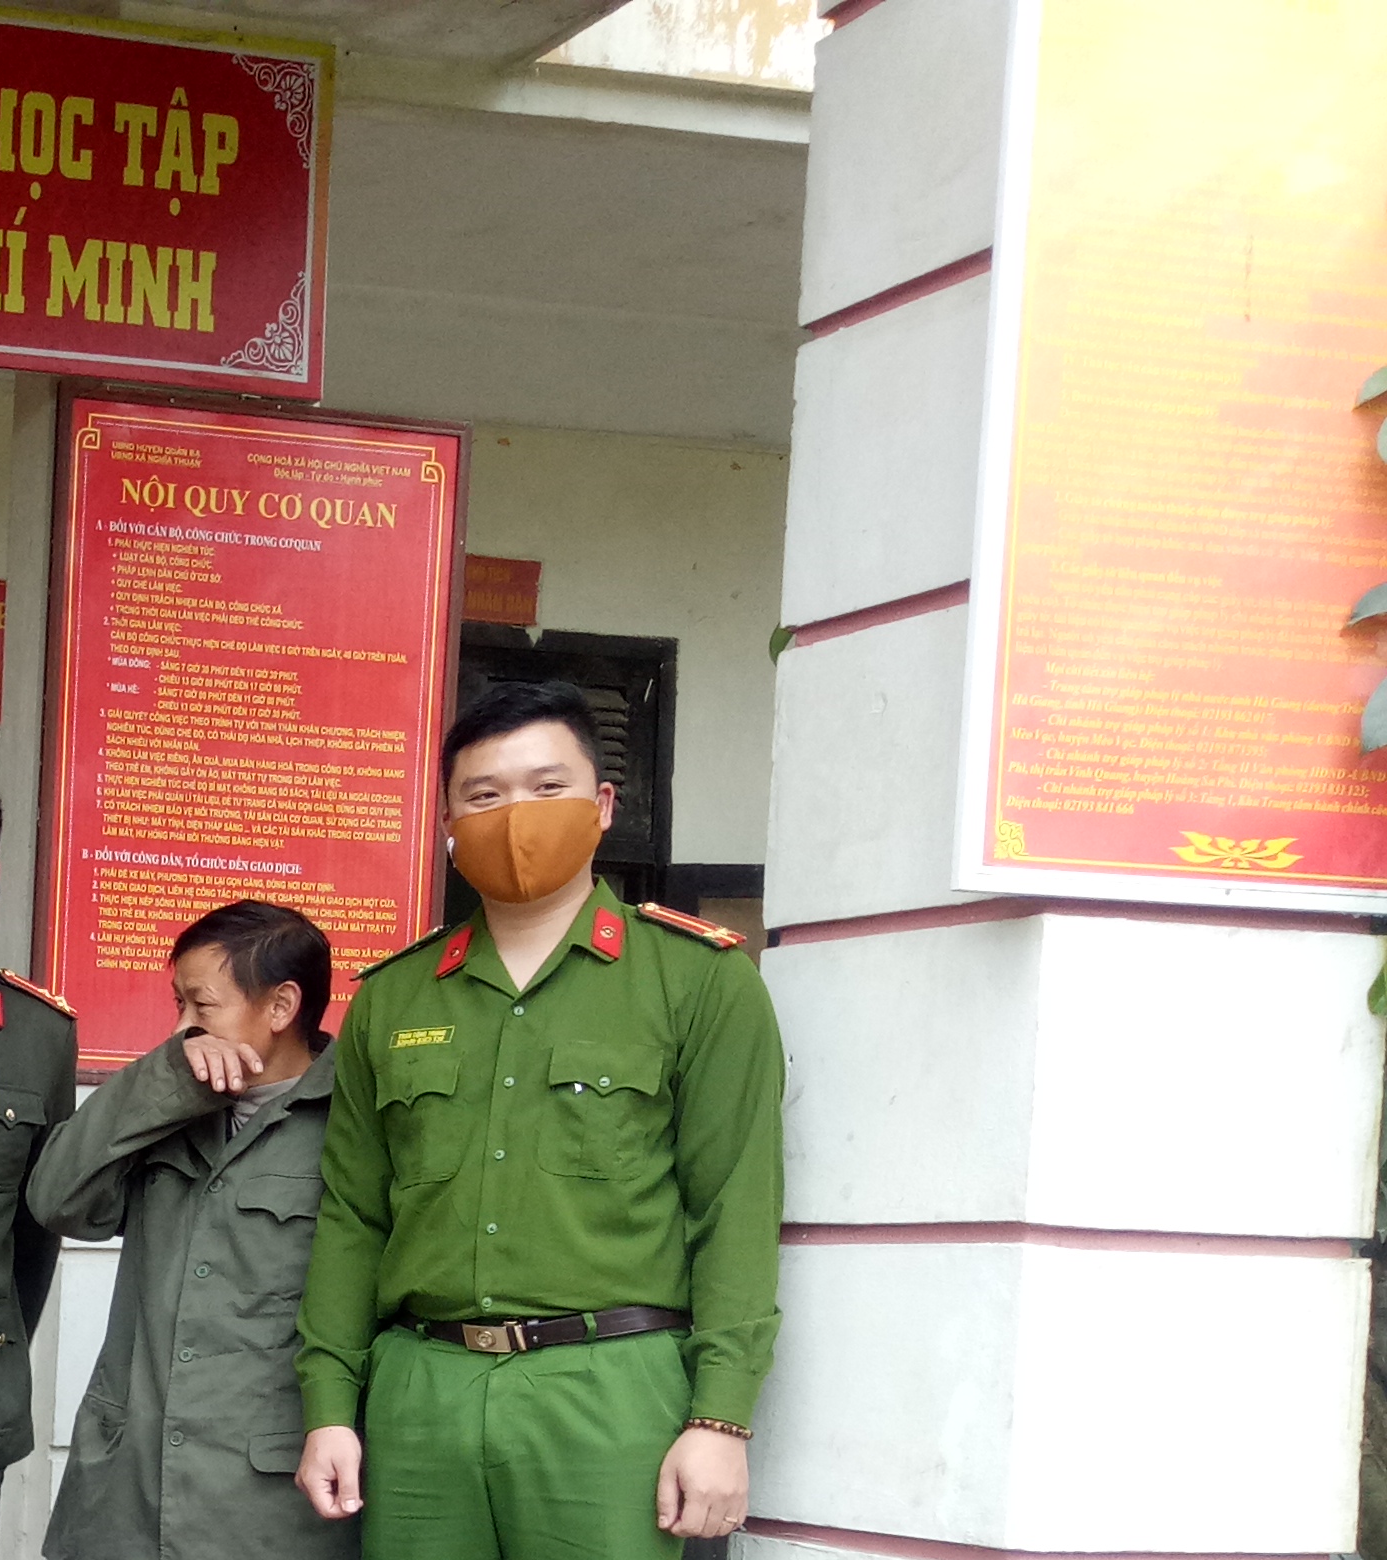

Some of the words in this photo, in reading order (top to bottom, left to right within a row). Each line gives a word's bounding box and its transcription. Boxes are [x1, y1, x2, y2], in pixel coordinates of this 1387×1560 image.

[114, 87, 239, 216] TẬP
[46, 236, 218, 333] MINH
[120, 474, 176, 513] NỘI
[184, 485, 251, 517] QUY
[258, 492, 303, 520] CƠ
[309, 497, 397, 529] QUAN
[244, 532, 280, 547] TRONG
[250, 859, 274, 873] GIAO
